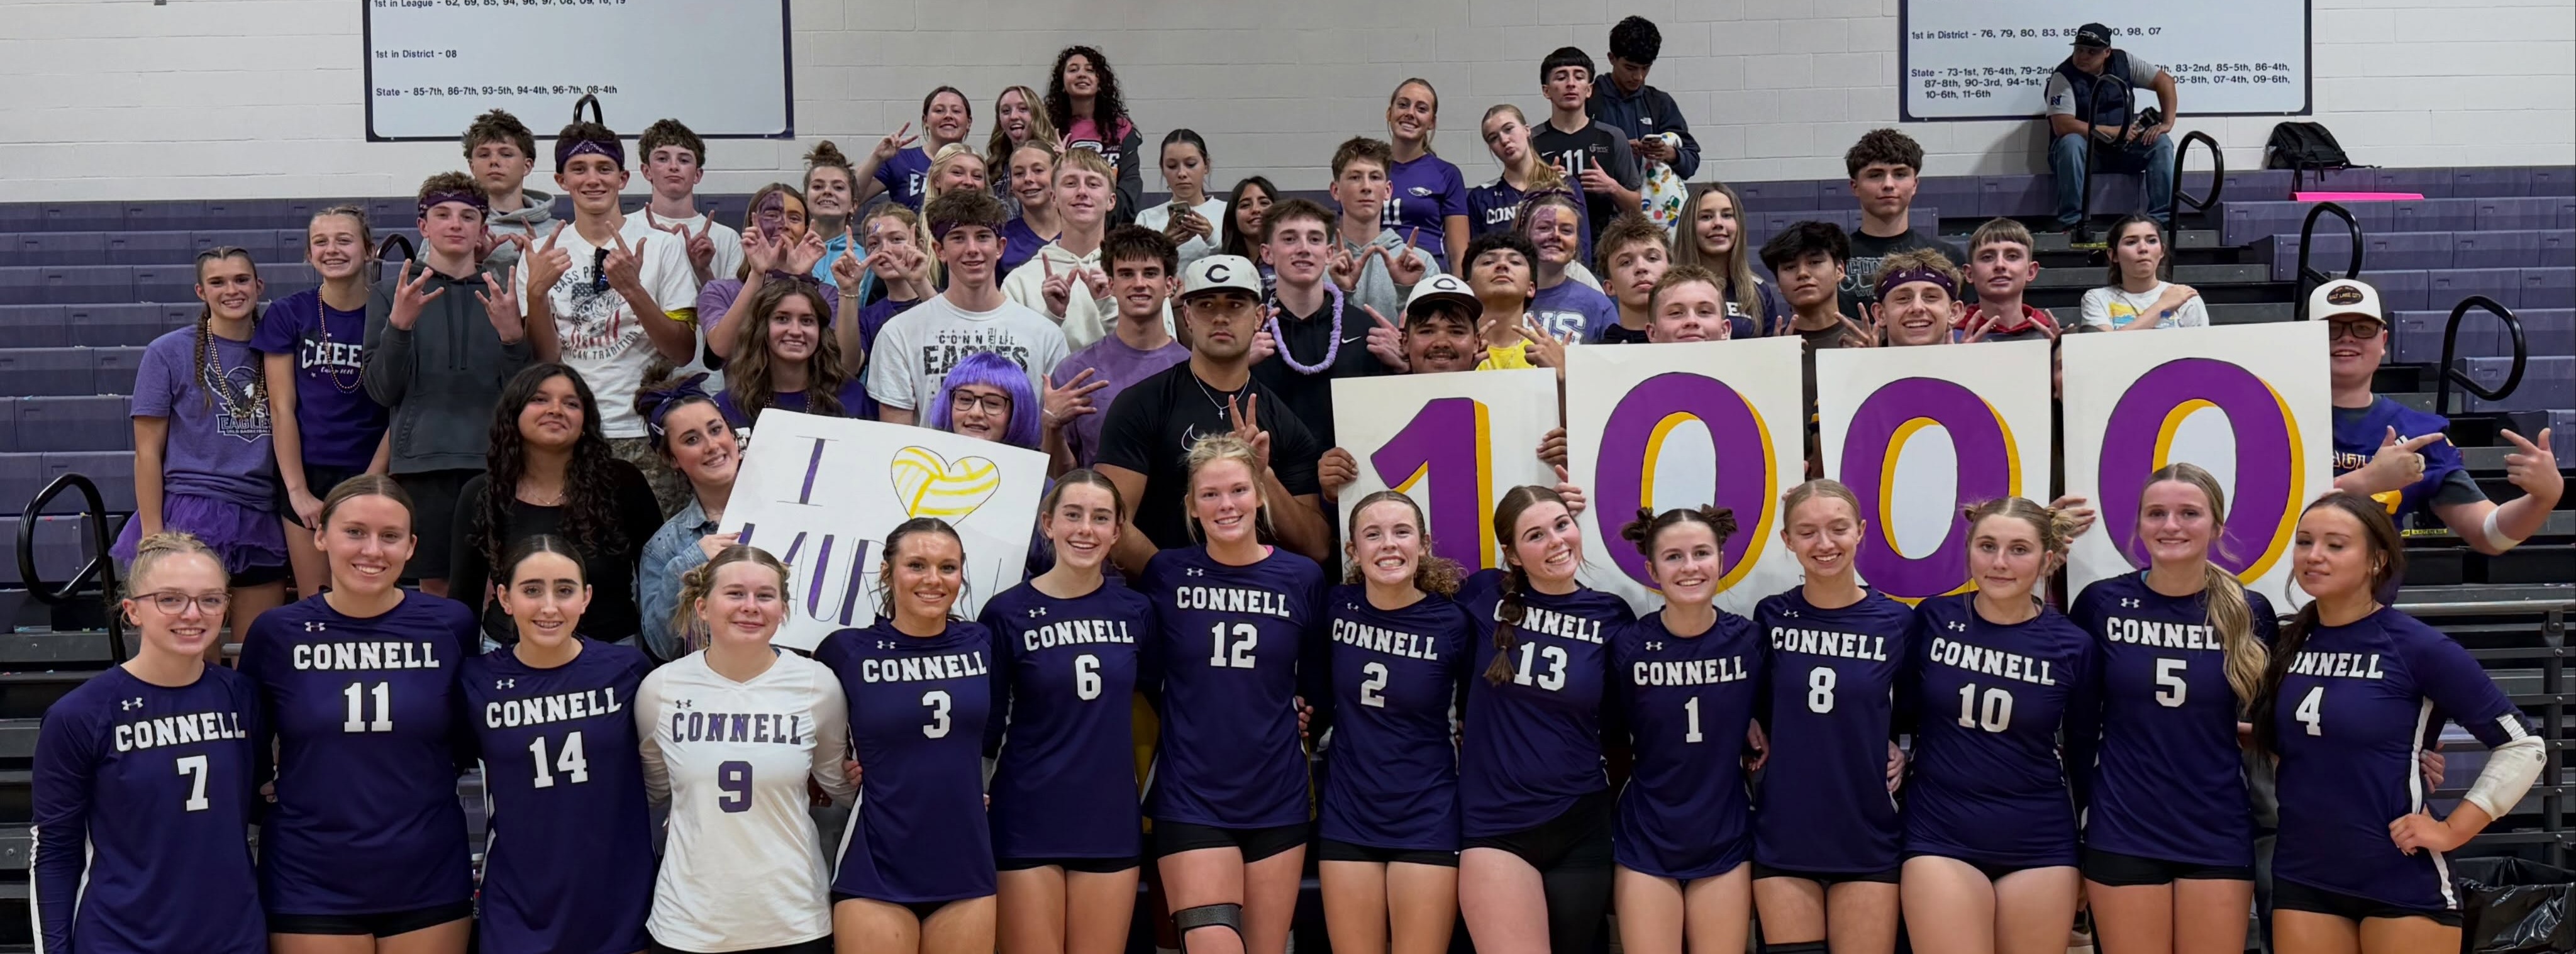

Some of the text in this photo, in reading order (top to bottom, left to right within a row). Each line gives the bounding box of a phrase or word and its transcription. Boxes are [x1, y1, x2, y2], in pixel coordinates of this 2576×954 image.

[402, 0, 433, 8] League
[1938, 31, 1968, 39] District
[1980, 30, 1996, 38] 76,
[2000, 30, 2016, 38] 79,
[2021, 29, 2037, 38] 80,
[2042, 29, 2058, 37] 83,
[2127, 28, 2144, 36] 98,
[1911, 69, 1935, 78] State
[1947, 67, 1979, 77] 73-1st,
[1982, 67, 2018, 76] 76-4th,
[1924, 79, 1961, 88] 87-8th,
[1965, 79, 2002, 87] 90-3rd,
[2006, 78, 2042, 87] 94-1st,
[2175, 64, 2212, 72] 83-2nd,
[2216, 64, 2251, 72] 85-5th,
[2255, 63, 2290, 72] 86-4th,
[2253, 75, 2290, 84] 09-6th,
[376, 87, 400, 96] State
[413, 87, 444, 96] 85-7th,
[448, 87, 479, 96] 86-7th,
[482, 86, 514, 96] 93-5th,
[517, 86, 549, 95] 94-4th,
[552, 86, 584, 94] 96-7th,
[587, 85, 618, 94] 08-4th
[1925, 90, 1991, 99] 10-6th, 11-6th
[1563, 150, 1584, 175] 11
[553, 270, 580, 293] BASS
[1205, 264, 1230, 283] C
[303, 339, 363, 369] CHEE
[593, 331, 640, 359] TRADITION
[777, 436, 840, 507] I
[1177, 586, 1290, 618] CONNELL
[1024, 620, 1134, 651] CONNELL
[1494, 599, 1603, 644] CNNELL
[2107, 617, 2221, 650] CONNEL
[294, 642, 440, 670] CONNELL
[1211, 621, 1257, 668] 12
[1333, 618, 1438, 660] CONNELL
[1772, 626, 1887, 662] CONNELL
[862, 651, 987, 683] CONNELL
[1075, 654, 1101, 701] 6
[1514, 641, 1567, 691] 13
[1634, 656, 1746, 685] CONNELL
[1931, 637, 2055, 686] CONNELL
[2287, 651, 2384, 679] ONNELL
[1361, 662, 1388, 707] 2
[1808, 667, 1836, 714] 8
[2156, 658, 2187, 707] 5
[344, 682, 392, 732] 11
[486, 687, 622, 728] CONNELL
[922, 691, 951, 738] 3
[1685, 697, 1702, 743] 1
[1959, 683, 2013, 733] 10
[2296, 686, 2324, 736] 4
[115, 712, 245, 752] CONNELL
[672, 712, 801, 745] CONNELL
[529, 731, 588, 788] 14
[177, 755, 209, 811] 7
[718, 760, 753, 813] 9
